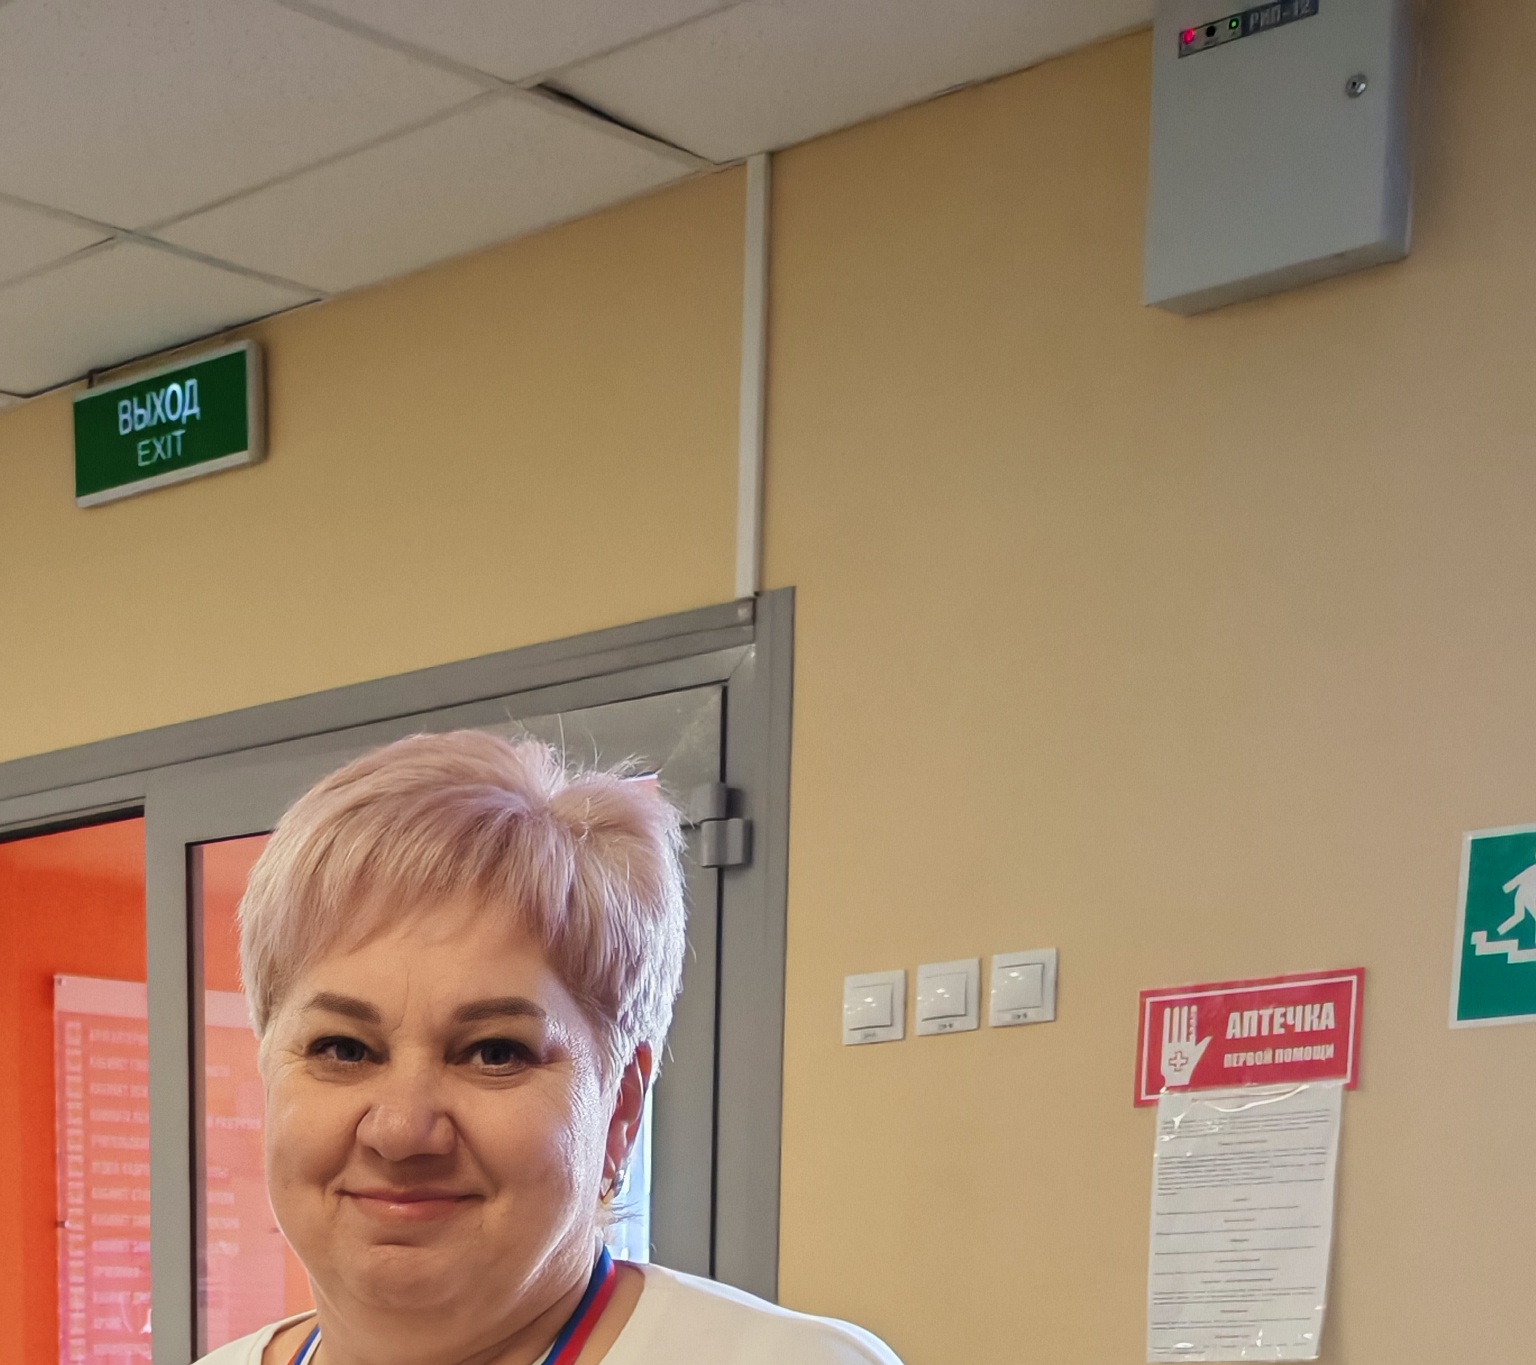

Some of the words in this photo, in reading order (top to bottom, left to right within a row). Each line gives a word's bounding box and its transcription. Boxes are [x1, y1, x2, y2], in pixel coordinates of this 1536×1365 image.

[119, 379, 200, 435] ВЫХОД
[137, 429, 186, 466] EXIT
[1225, 1002, 1336, 1039] АПТЕЧКА
[1223, 1047, 1273, 1068] ПЕРВОЙ
[1274, 1044, 1335, 1064] ПОМОЩИ
